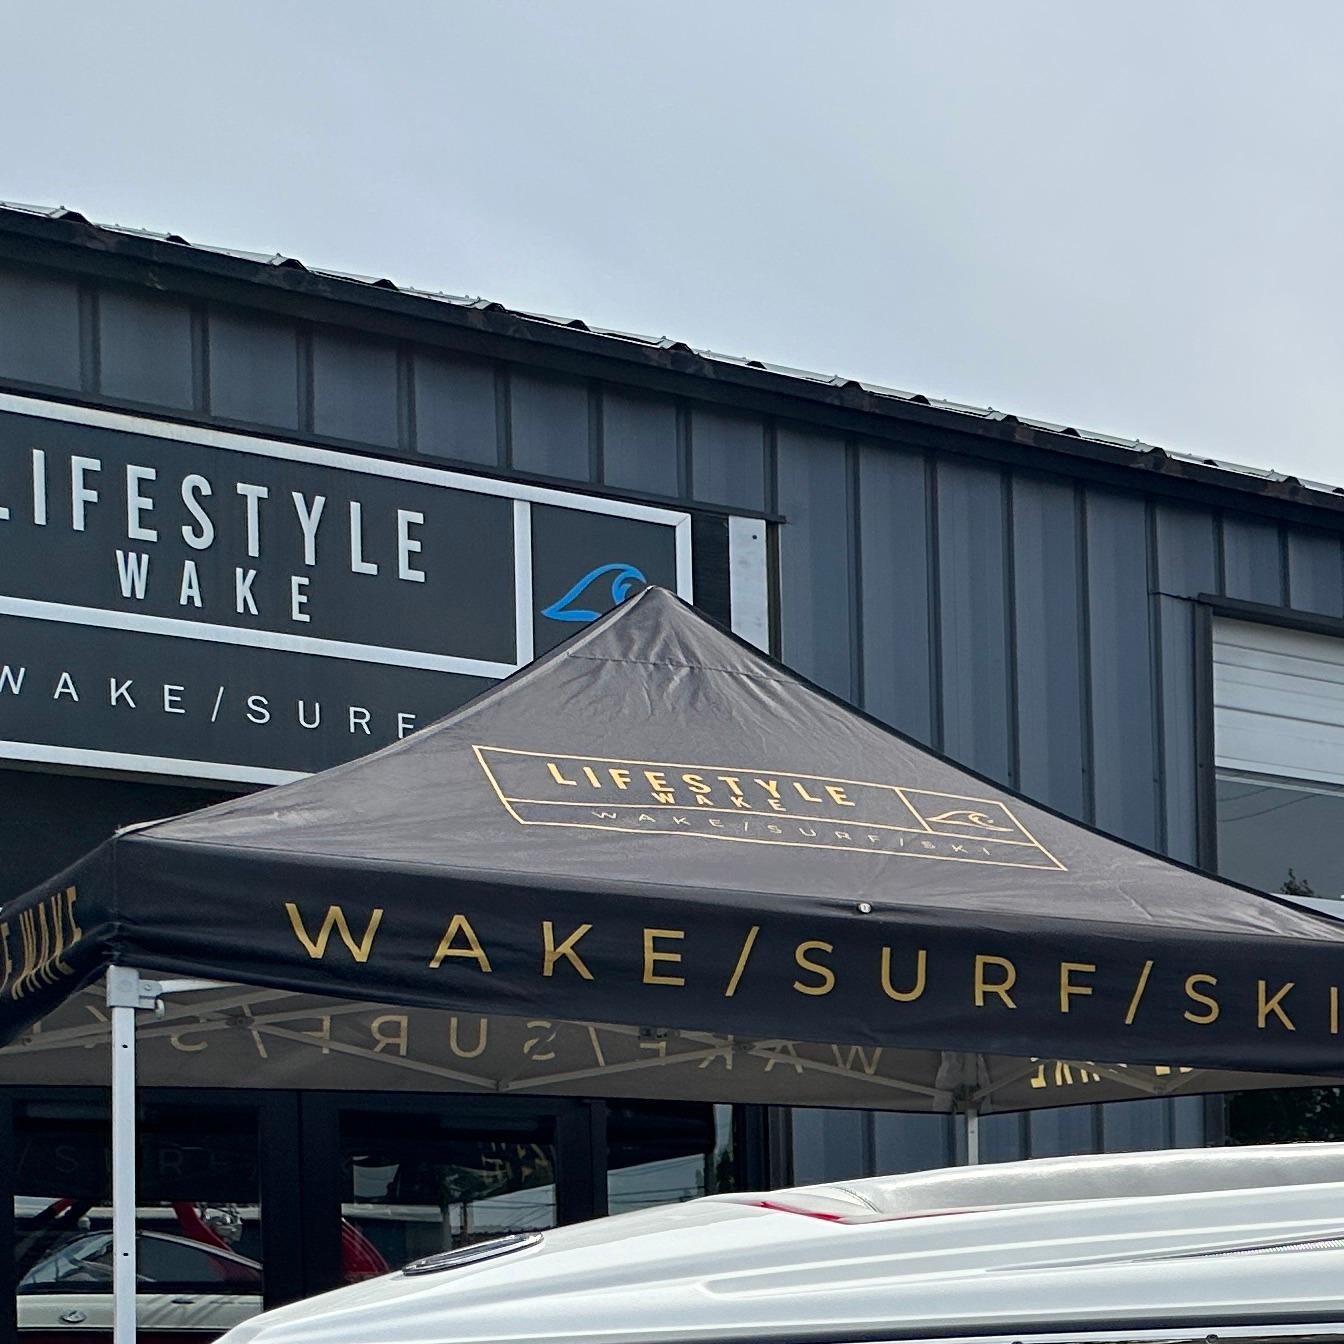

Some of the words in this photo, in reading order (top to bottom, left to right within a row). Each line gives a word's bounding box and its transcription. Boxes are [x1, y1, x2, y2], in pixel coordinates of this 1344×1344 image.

[115, 549, 312, 623] WAKE
[547, 763, 856, 807] LIFESTYLE
[651, 792, 787, 812] WAKE
[285, 902, 1341, 1036] WAKE/SURF/SKI
